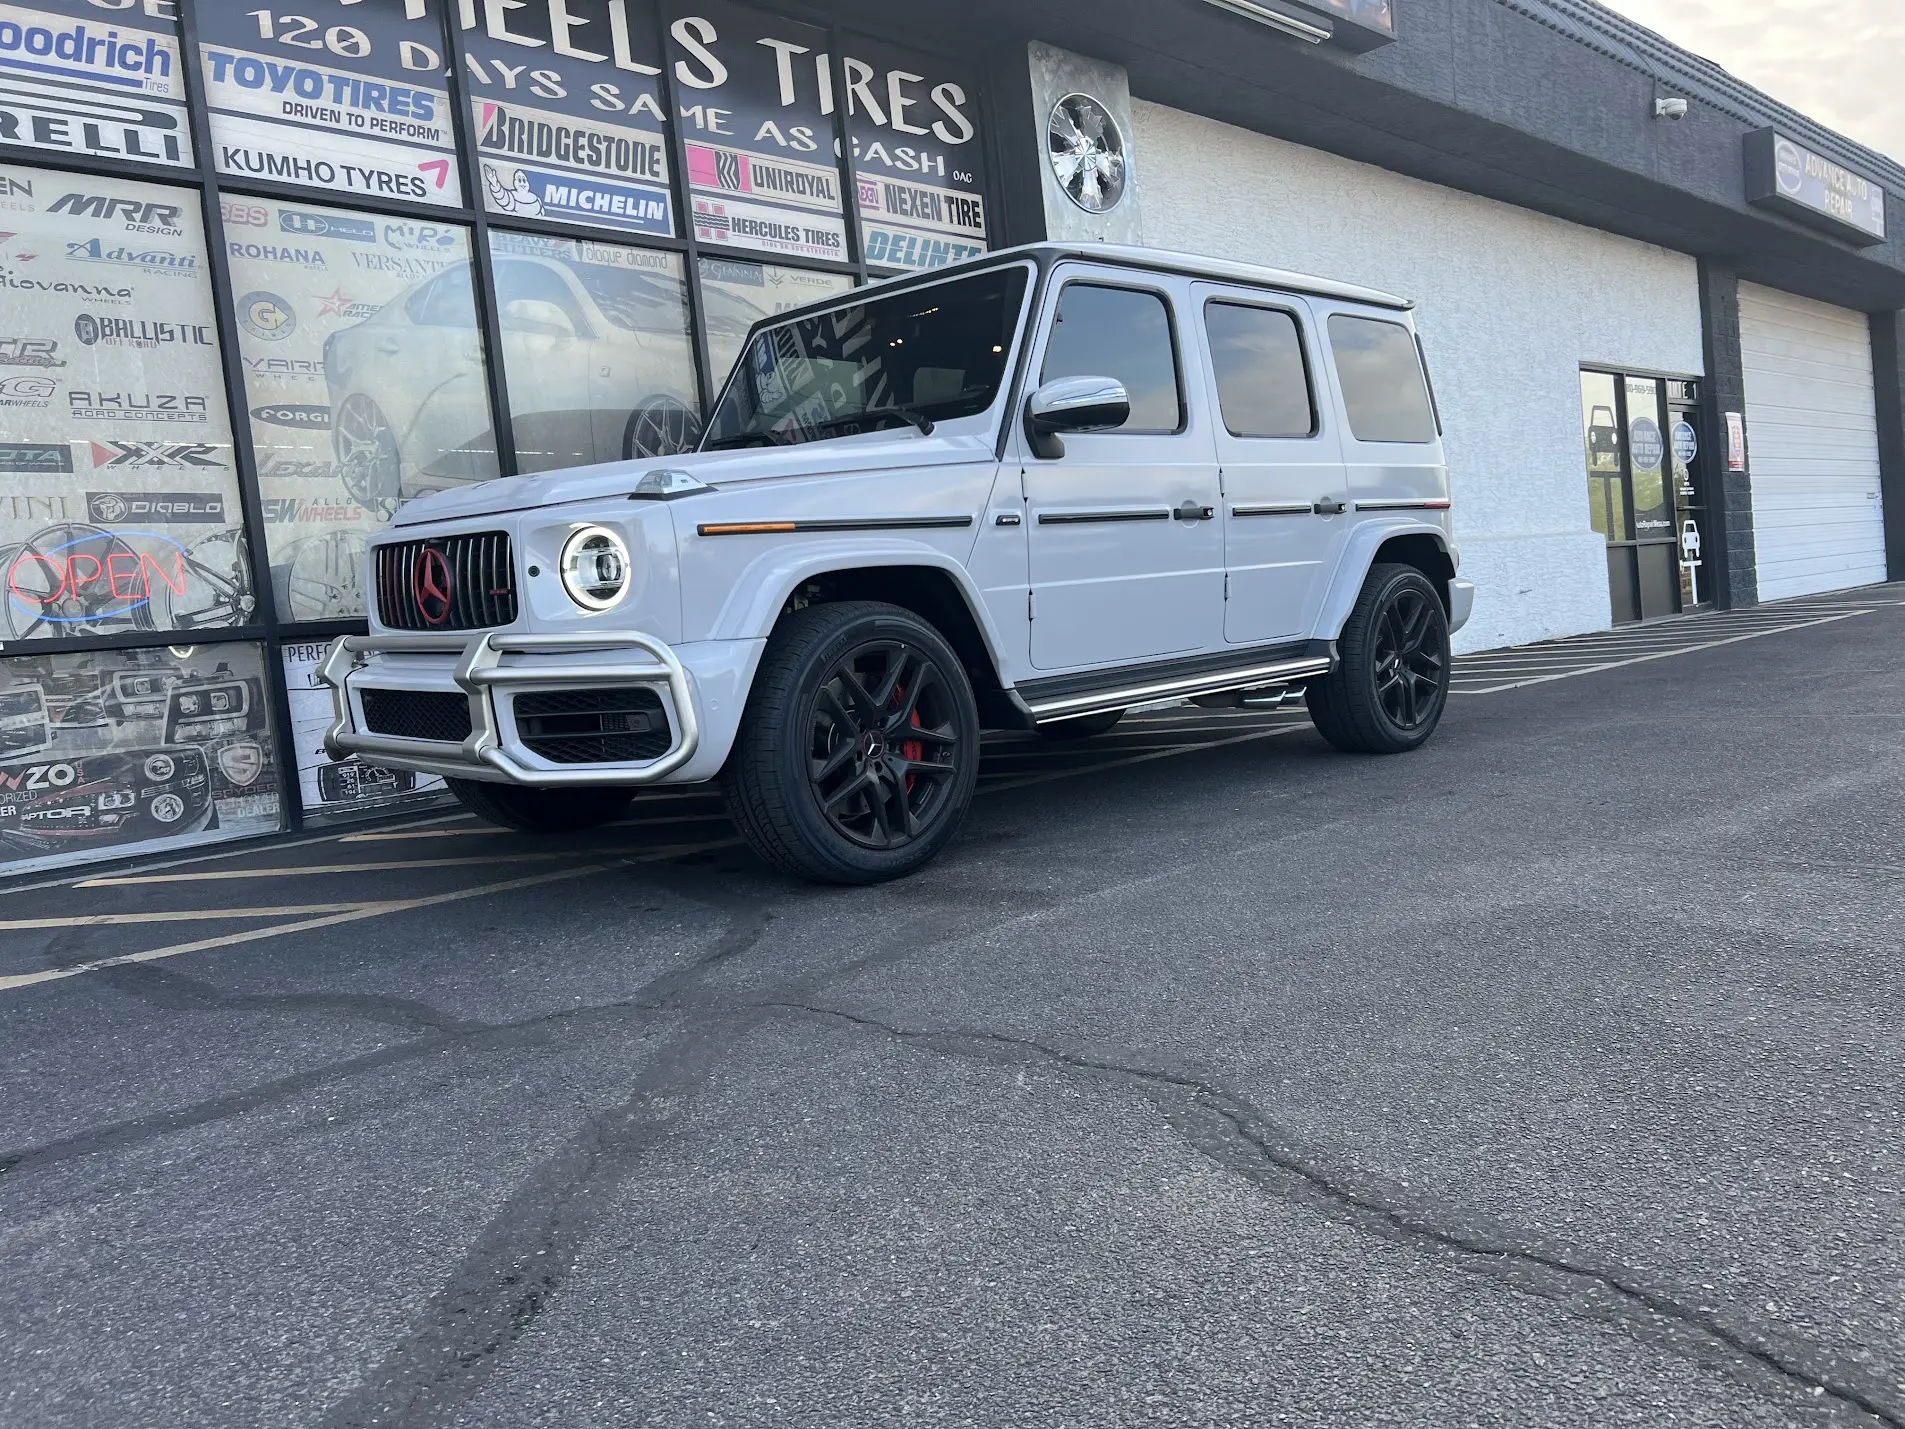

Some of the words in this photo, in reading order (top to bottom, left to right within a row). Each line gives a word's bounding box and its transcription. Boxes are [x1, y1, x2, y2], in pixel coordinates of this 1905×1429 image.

[143, 77, 170, 93] Tires
[245, 10, 371, 57] 120
[588, 83, 735, 135] SAME
[754, 120, 817, 151] AS
[833, 135, 945, 176] CASH
[756, 38, 974, 145] TIRES
[282, 101, 341, 124] DRIVEN
[347, 112, 365, 128] TO
[369, 117, 440, 142] PERFORM
[481, 103, 661, 178] BRIDGESTONE
[222, 146, 336, 184] KUMHO
[340, 165, 427, 198] TYRES
[752, 164, 836, 200] UNIROYAL
[1805, 153, 1845, 190] ADVANCE
[1845, 174, 1868, 200] AUTO
[46, 193, 183, 227] MRR
[544, 184, 665, 220] MICHELIN
[884, 183, 942, 221] NEXEN
[943, 195, 982, 228] TIRE
[1824, 189, 1853, 219] REPAIR
[124, 222, 183, 237] DESIGN
[731, 216, 800, 242] HERCULES
[803, 226, 841, 248] TIRES
[66, 238, 196, 268] Advanti
[229, 242, 326, 265] ROHANA
[626, 248, 668, 269] diamond
[143, 268, 198, 279] RACING
[789, 274, 832, 286] VERDE
[99, 316, 214, 345] BALLISTIC
[69, 391, 207, 411] AKUZA
[124, 411, 208, 421] CONCEPTS
[131, 501, 221, 514] DIABLO
[299, 506, 363, 522] WHEELS
[9, 551, 187, 604] OPEN
[211, 783, 277, 799] SPYDER
[237, 803, 280, 818] DEALER
